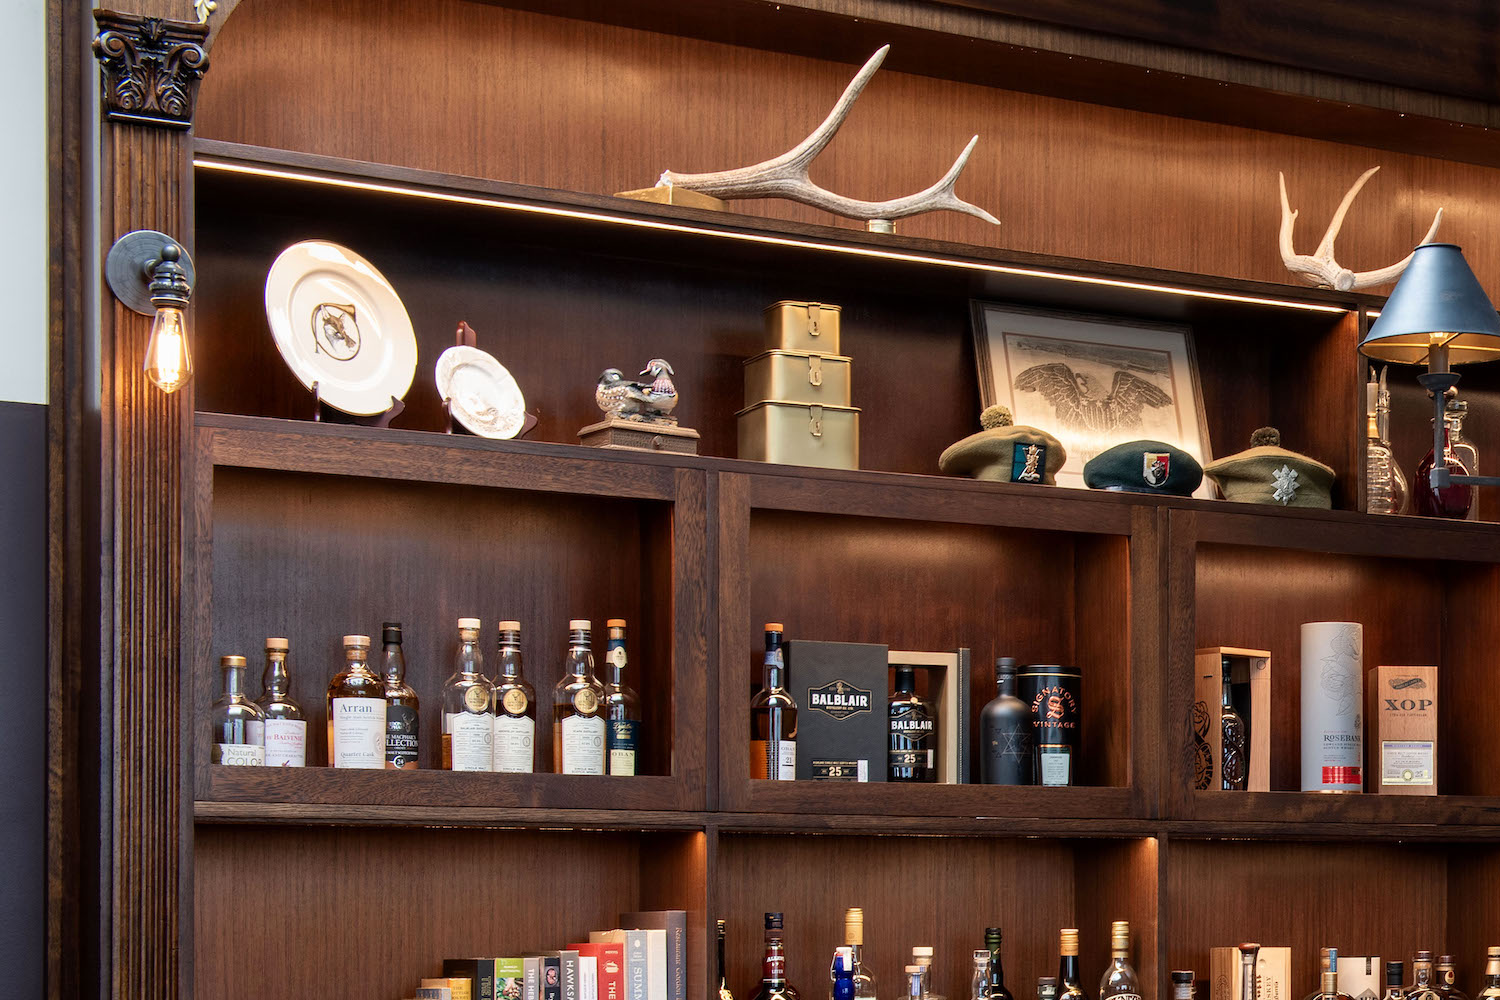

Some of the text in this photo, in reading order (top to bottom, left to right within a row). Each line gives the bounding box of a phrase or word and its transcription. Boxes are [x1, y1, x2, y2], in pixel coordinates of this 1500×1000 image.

[811, 693, 868, 707] BALBLAIR
[1031, 686, 1078, 713] SIGNATORY
[1384, 699, 1433, 711] XOP
[339, 704, 372, 713] Arran
[891, 720, 933, 730] BALBLAIR
[1032, 721, 1076, 729] VINTAGE
[227, 748, 257, 757] Natural
[903, 754, 916, 763] 25
[828, 766, 842, 777] 25
[675, 927, 683, 965] Restaurant
[527, 968, 535, 981] THE
[480, 976, 491, 996] THE
[675, 967, 683, 995] Gordon
[608, 981, 616, 1000] THE
